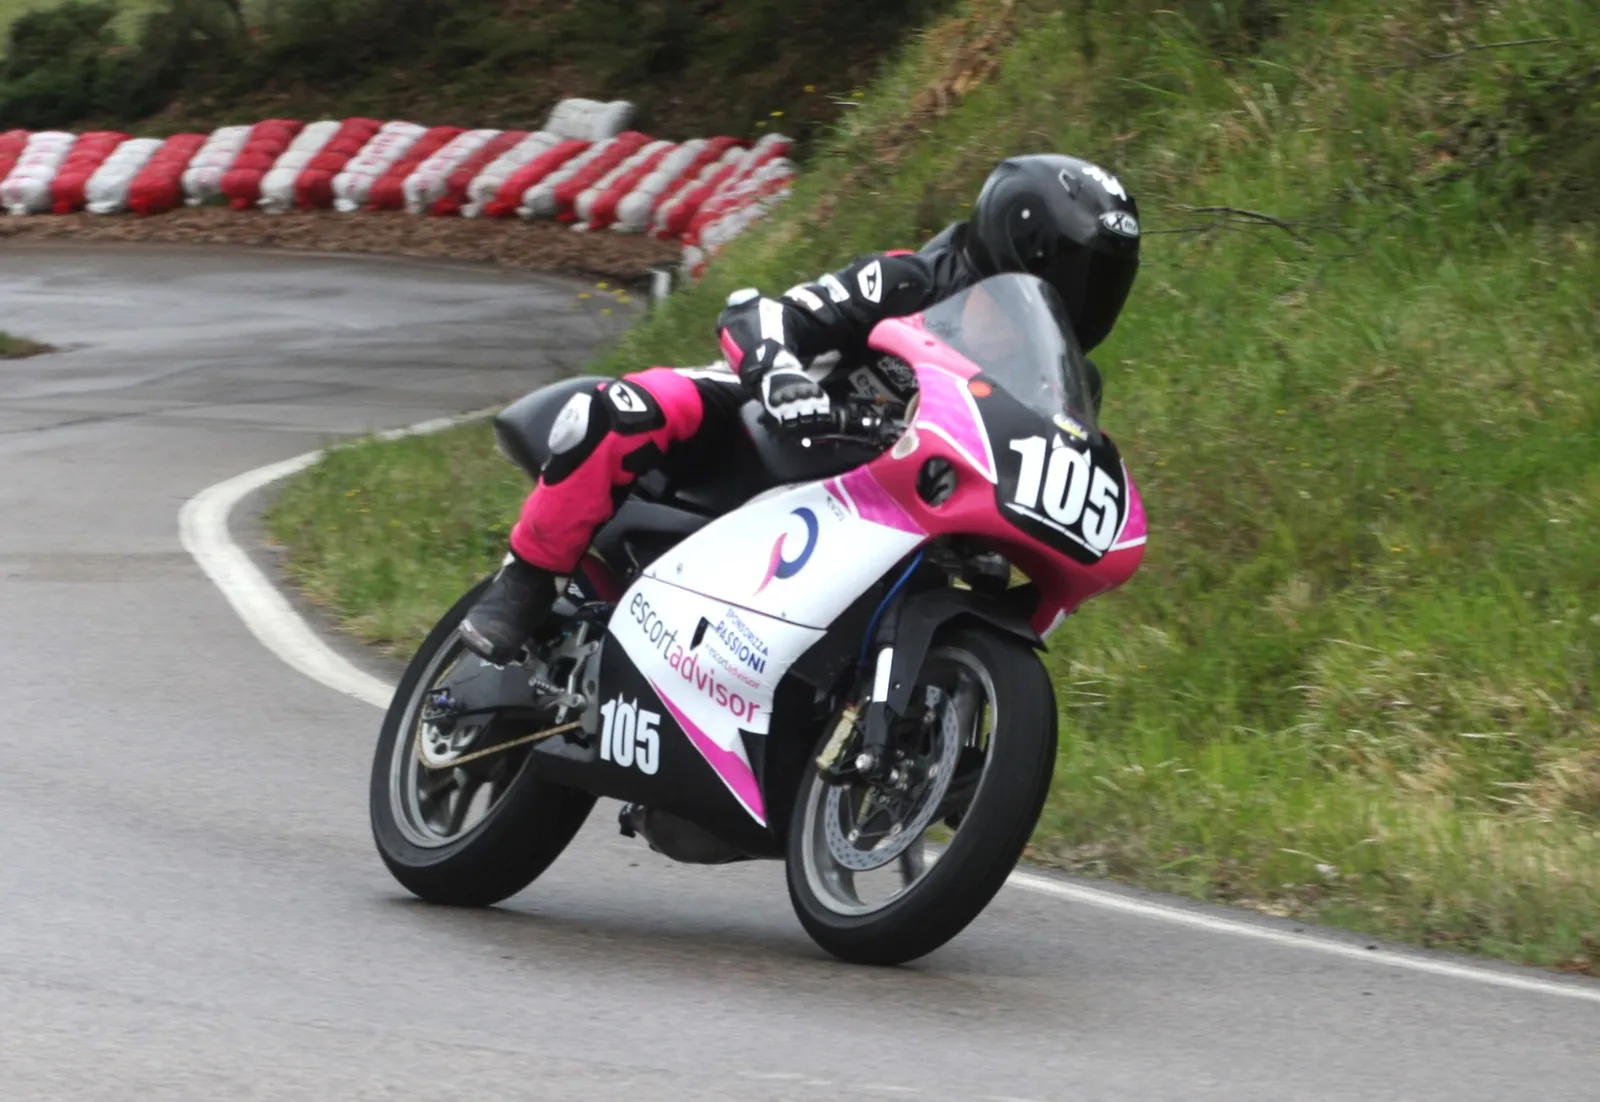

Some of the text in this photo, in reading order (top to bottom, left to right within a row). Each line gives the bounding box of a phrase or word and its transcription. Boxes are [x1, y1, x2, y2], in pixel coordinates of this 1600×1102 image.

[1009, 434, 1119, 551] 105
[630, 592, 761, 723] escortadvisor
[715, 620, 766, 675] PASSIONI
[600, 692, 661, 775] 105
